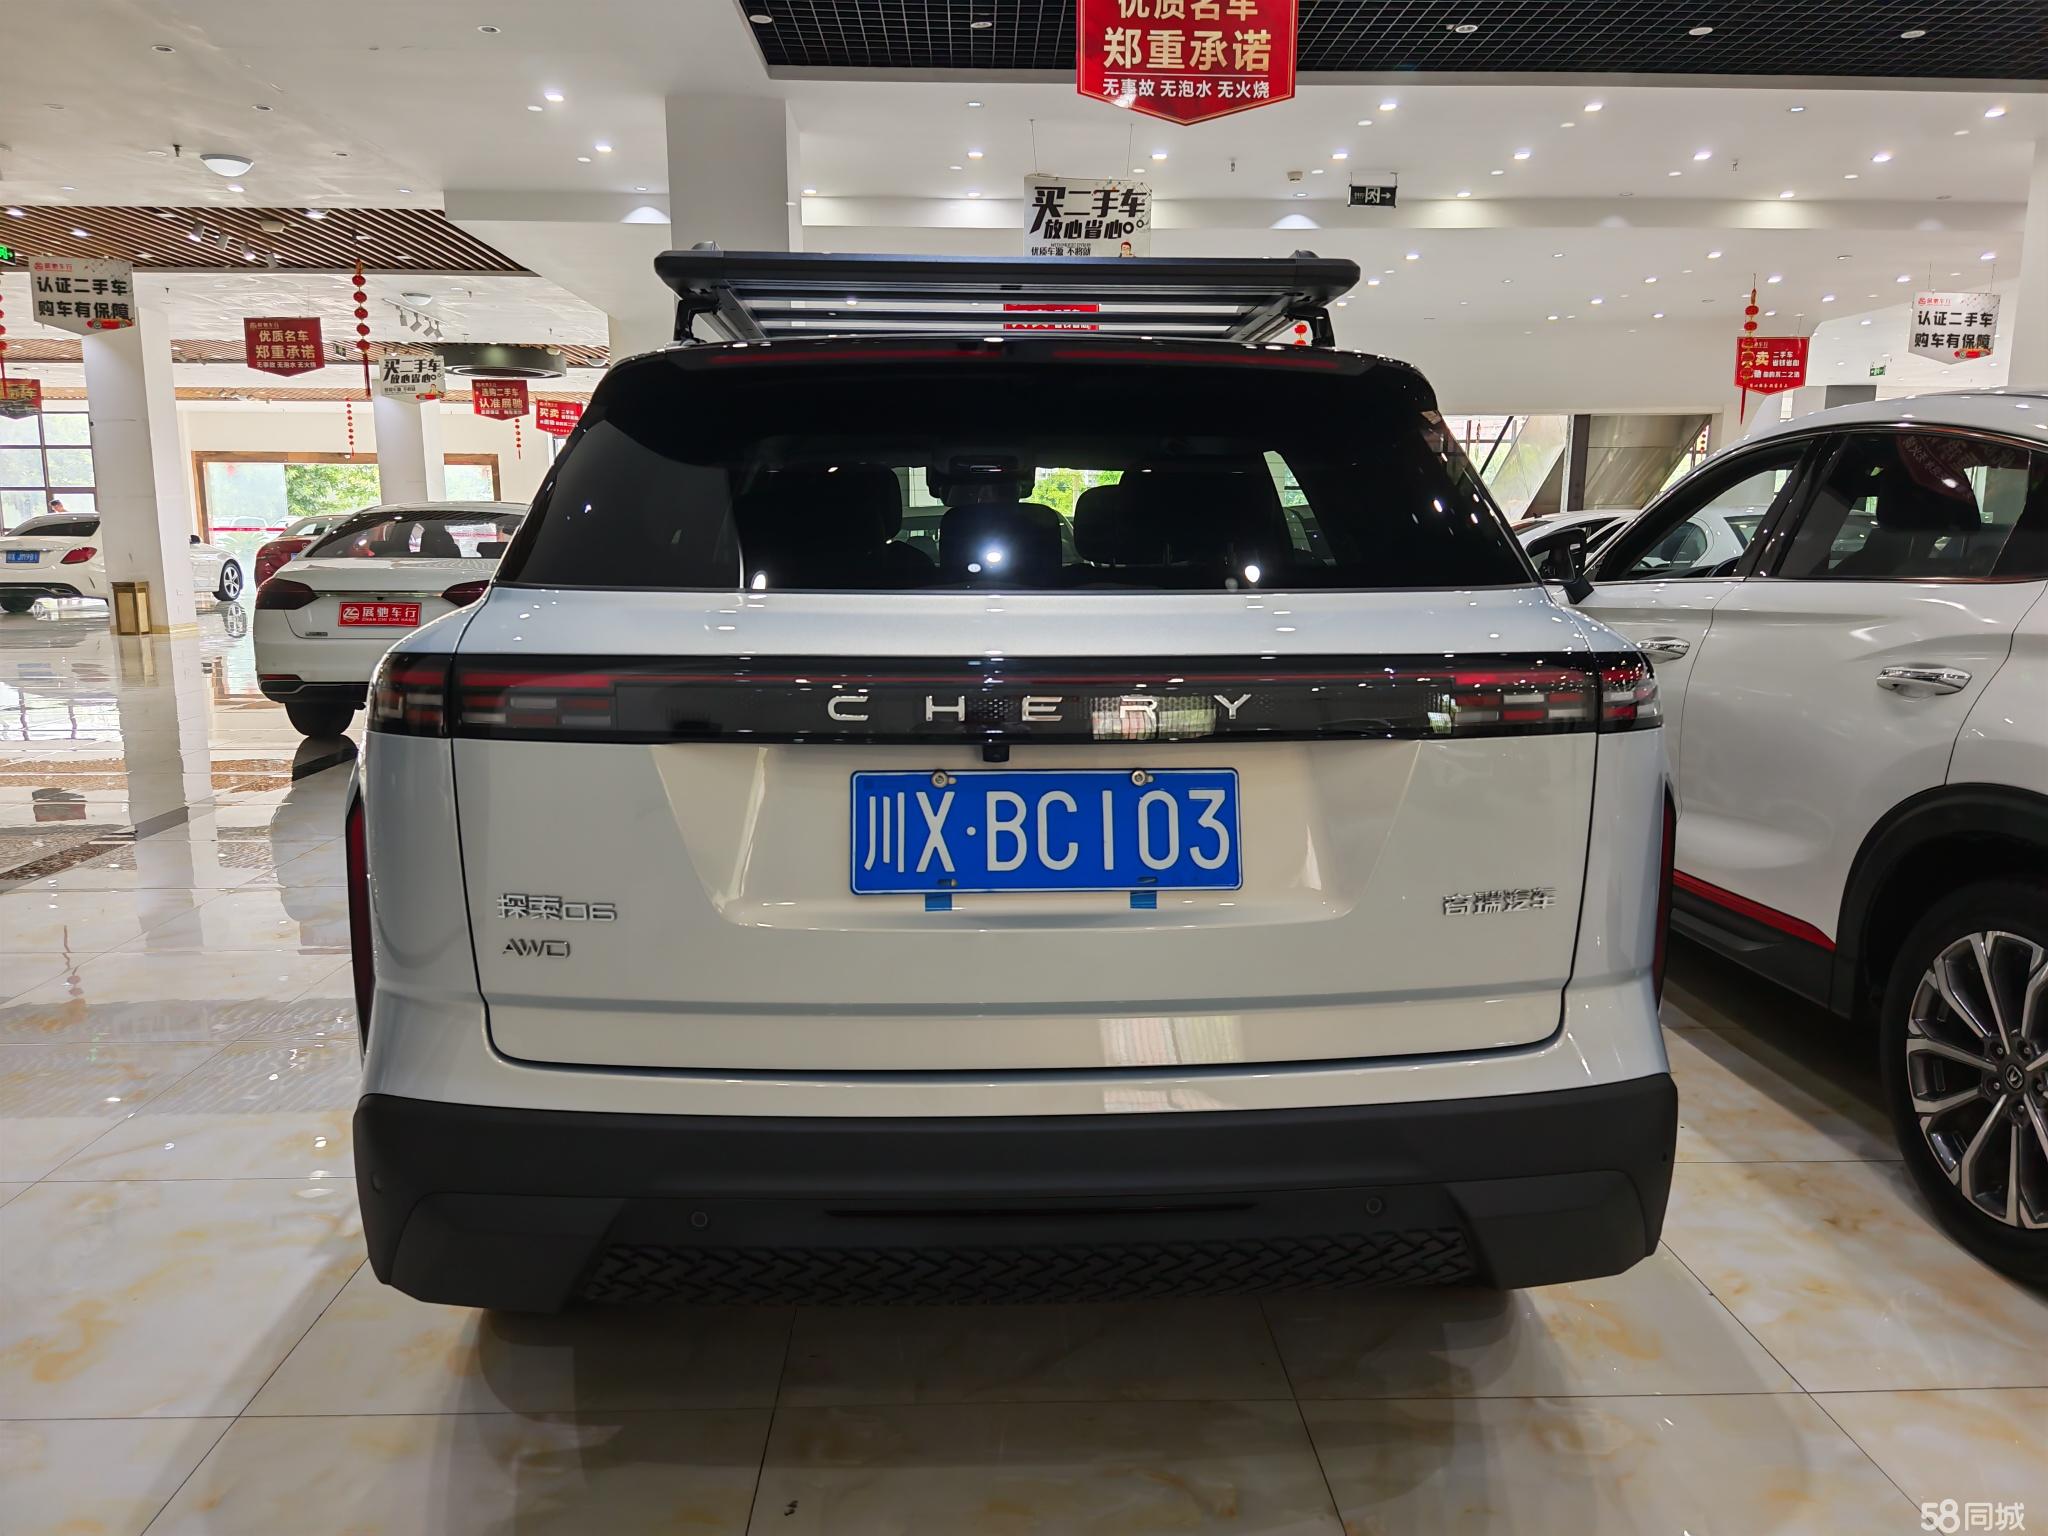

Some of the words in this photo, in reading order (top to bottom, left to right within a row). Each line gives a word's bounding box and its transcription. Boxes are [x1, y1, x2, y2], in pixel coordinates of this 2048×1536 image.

[1103, 27, 1272, 72] 郑重承诺
[1103, 78, 1155, 97] 无事故
[1160, 80, 1212, 98] 无泡水
[1217, 80, 1270, 99] 无火烧
[1030, 186, 1147, 234] 买二手车
[1043, 219, 1123, 239] 放心省心
[37, 276, 128, 296] 认证二手车
[38, 300, 129, 320] 购车有保障
[1918, 310, 1993, 327] 认证二手车
[259, 330, 309, 342] 优质名车
[1914, 332, 1991, 349] 购车有保障
[255, 344, 315, 359] 郑重承诺
[383, 359, 441, 381] 买二手车
[362, 606, 417, 618] 展驰车行
[828, 693, 1251, 721] CHERY
[497, 892, 617, 922] 探索06
[1443, 886, 1557, 916] 奇瑞汽车
[502, 937, 571, 958] AWD
